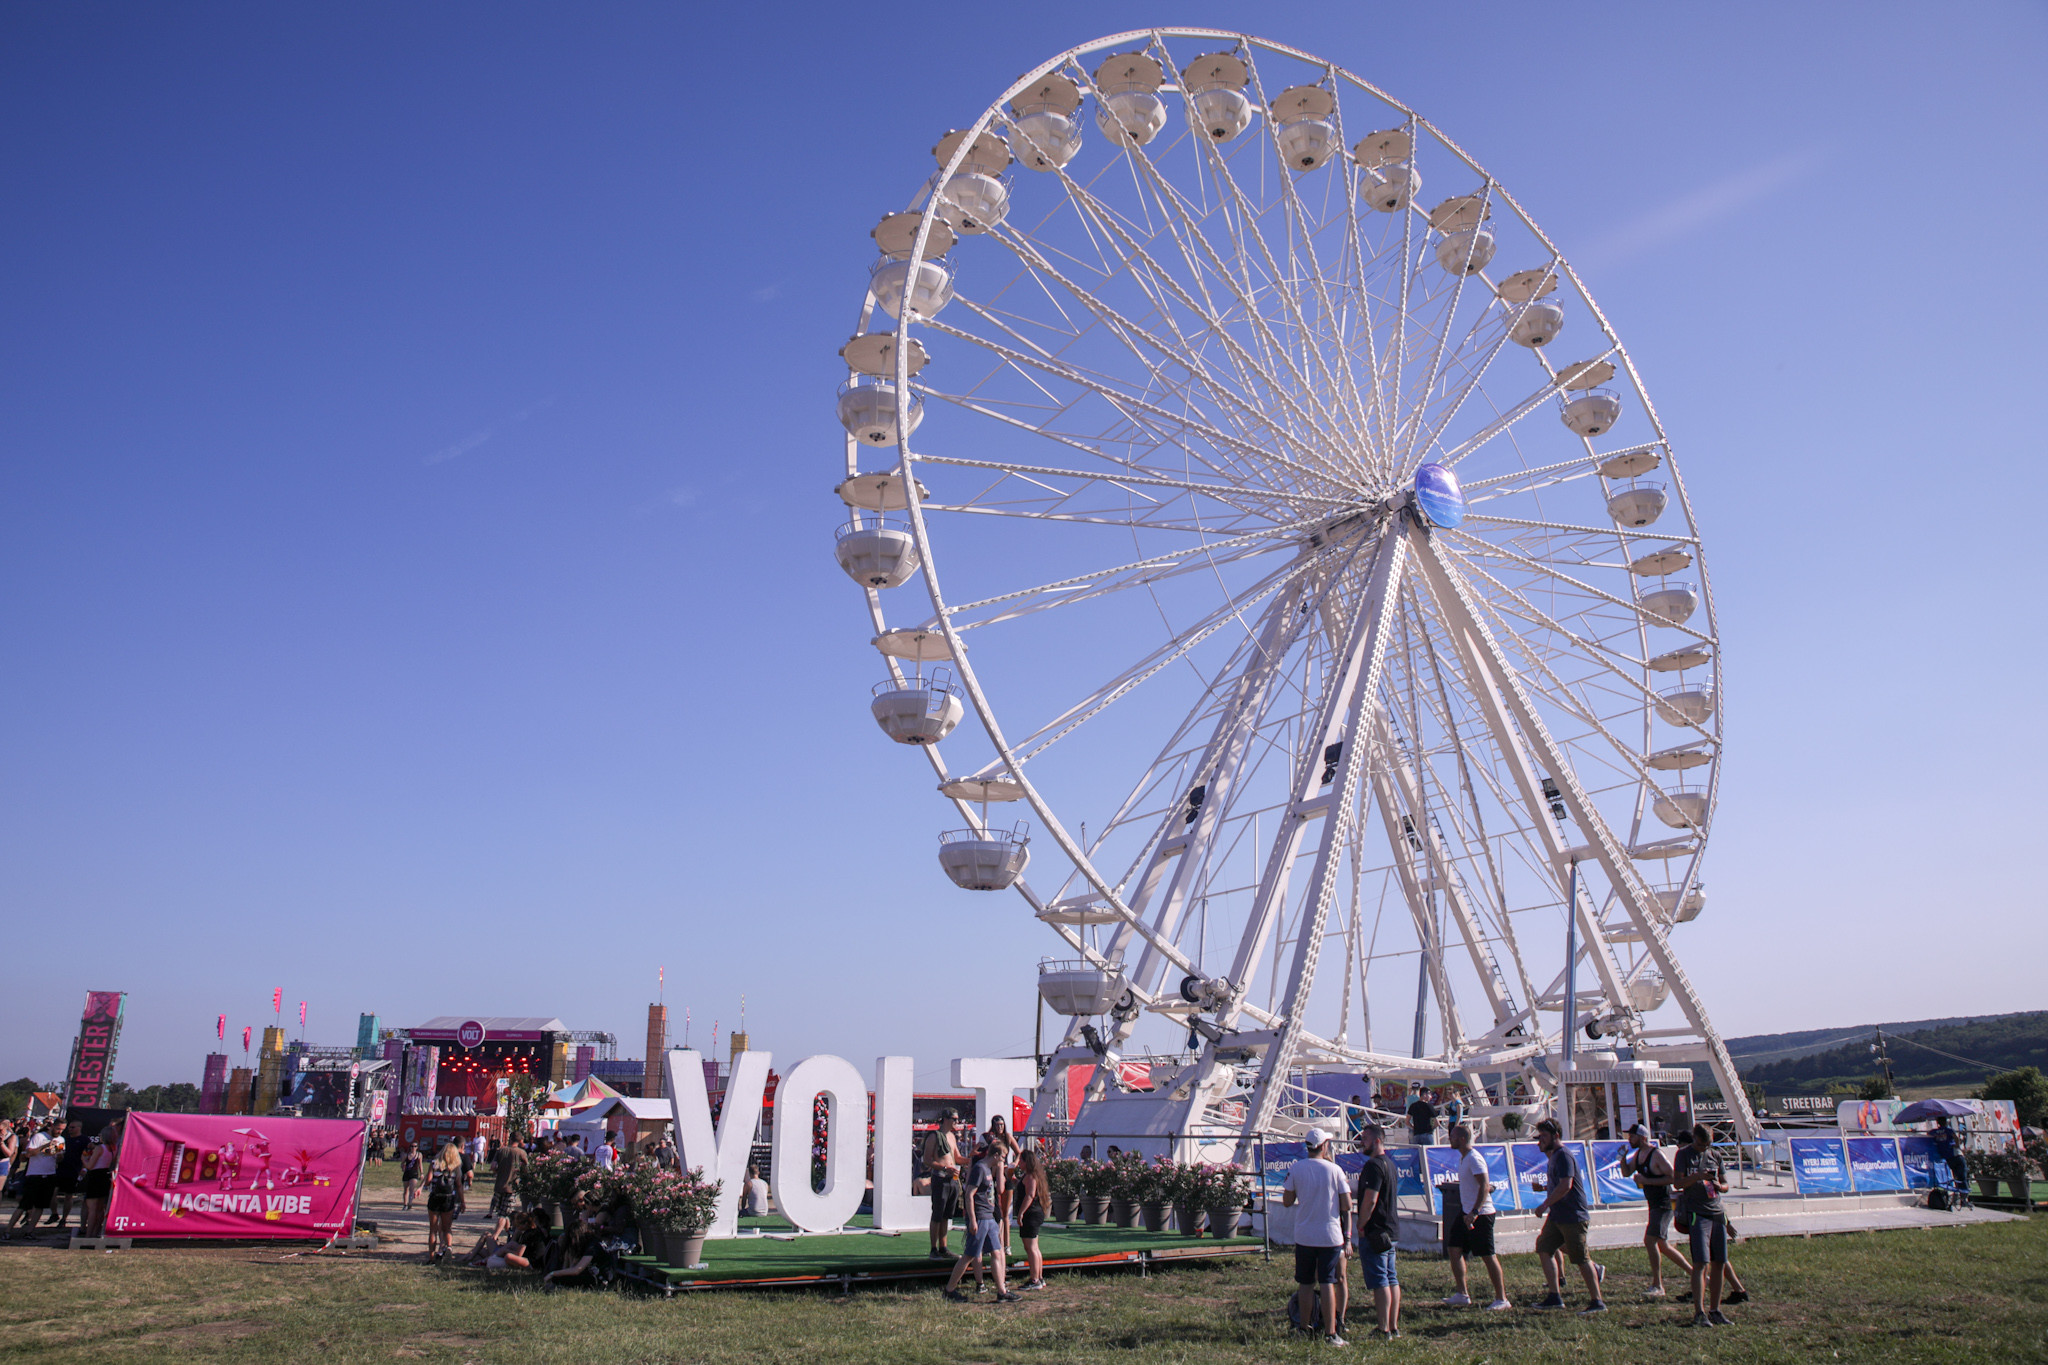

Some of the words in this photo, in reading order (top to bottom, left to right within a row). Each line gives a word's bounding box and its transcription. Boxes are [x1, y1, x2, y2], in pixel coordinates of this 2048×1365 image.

[462, 1030, 480, 1040] VOLT
[72, 1025, 109, 1107] CHESTER
[444, 1095, 477, 1116] LOVE
[1693, 1103, 1708, 1111] ACK
[1782, 1097, 1834, 1110] STREETBAR
[664, 1050, 1038, 1239] VOLT
[1852, 1160, 1898, 1172] HungaroControl
[1433, 1169, 1460, 1186] IRÁN
[161, 1193, 262, 1213] MAGENTA
[266, 1195, 312, 1214] VIBE
